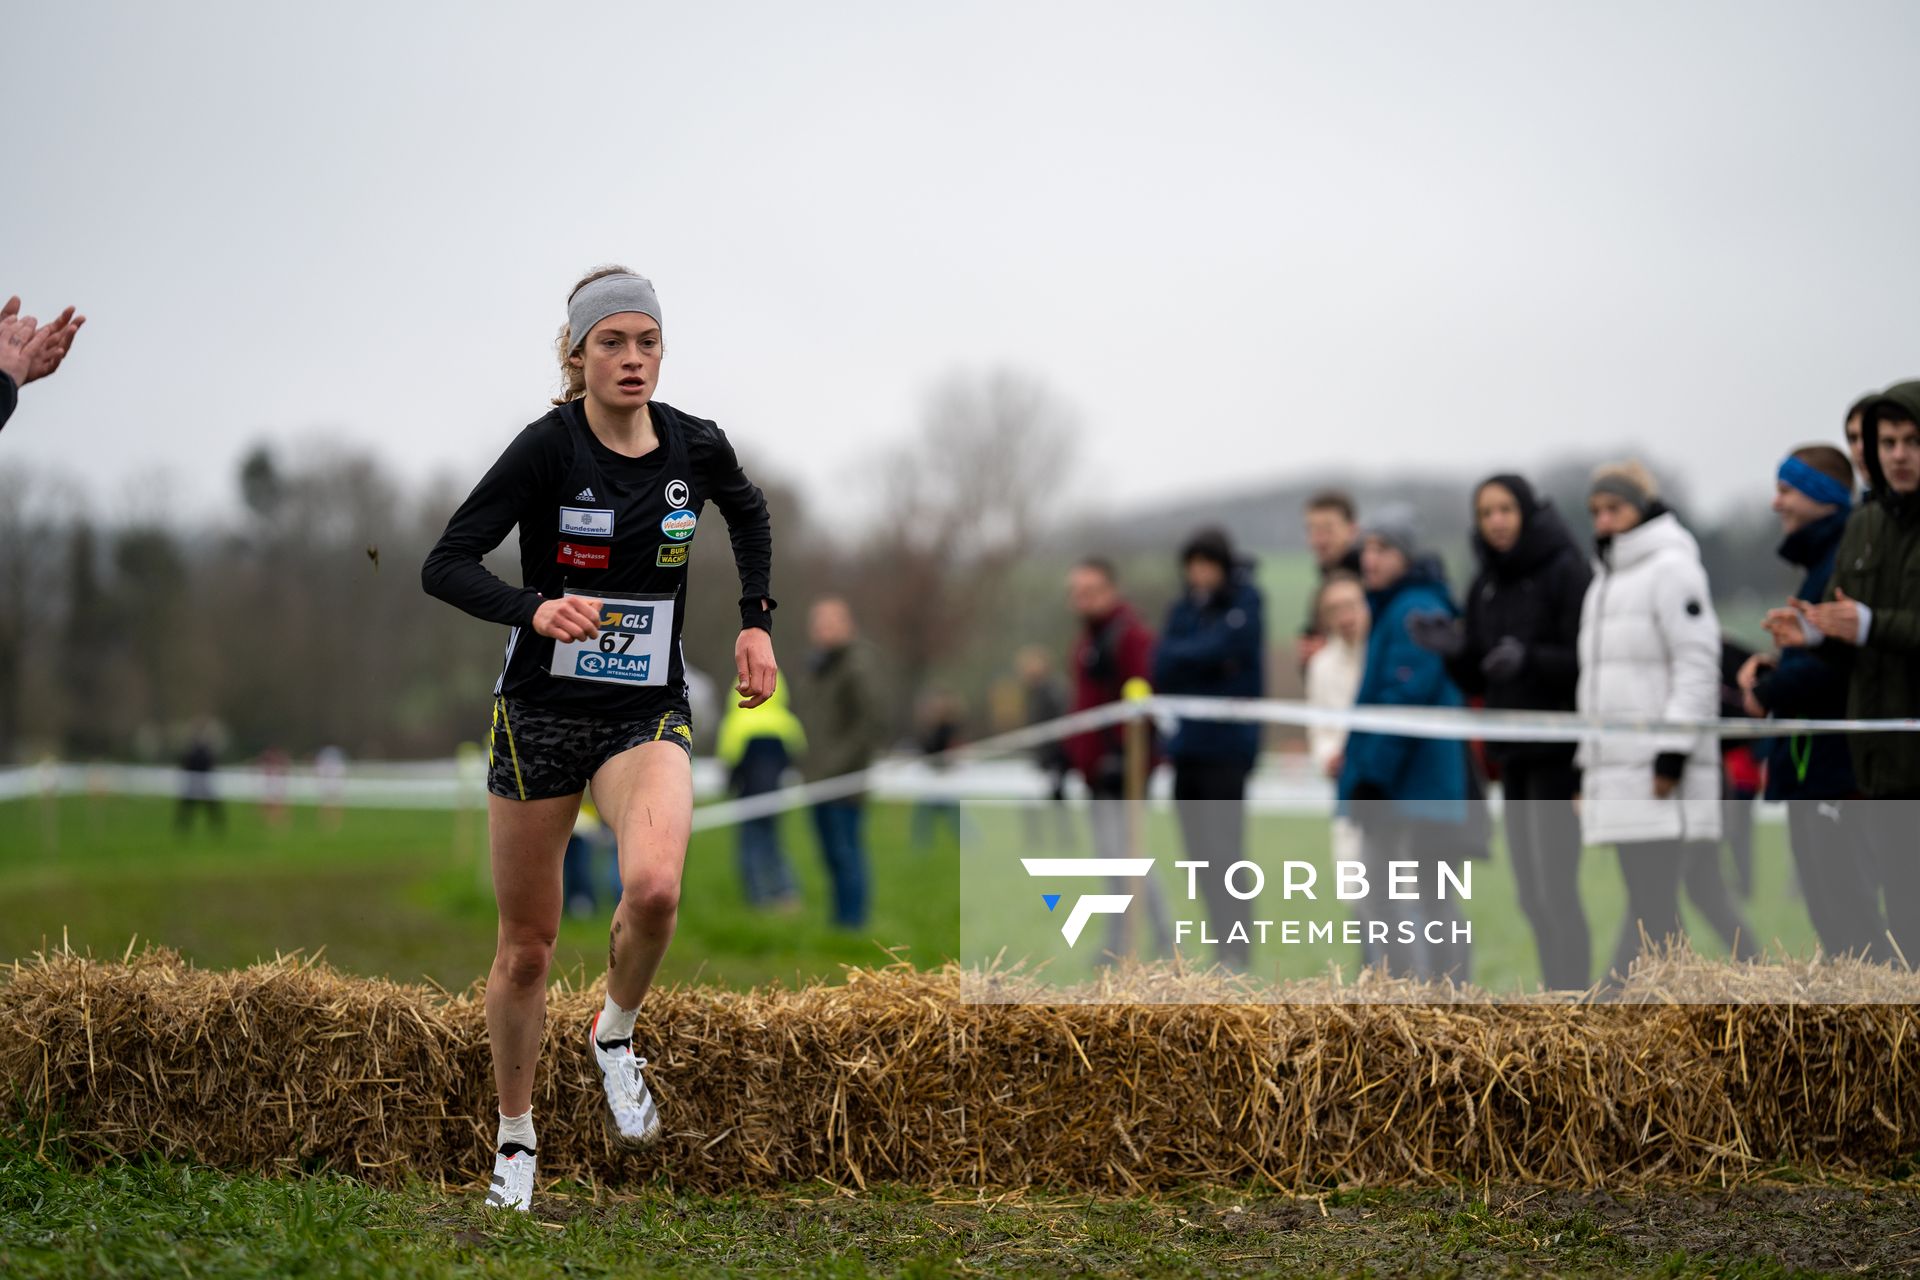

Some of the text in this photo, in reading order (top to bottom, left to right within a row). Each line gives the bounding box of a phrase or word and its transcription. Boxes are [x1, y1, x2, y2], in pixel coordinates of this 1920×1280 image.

[565, 524, 608, 533] Bundeswehr
[574, 550, 606, 560] Sparkasse
[573, 558, 586, 566] Ulm
[622, 614, 649, 629] GLS
[599, 632, 635, 655] 67
[608, 657, 648, 672] PLAN
